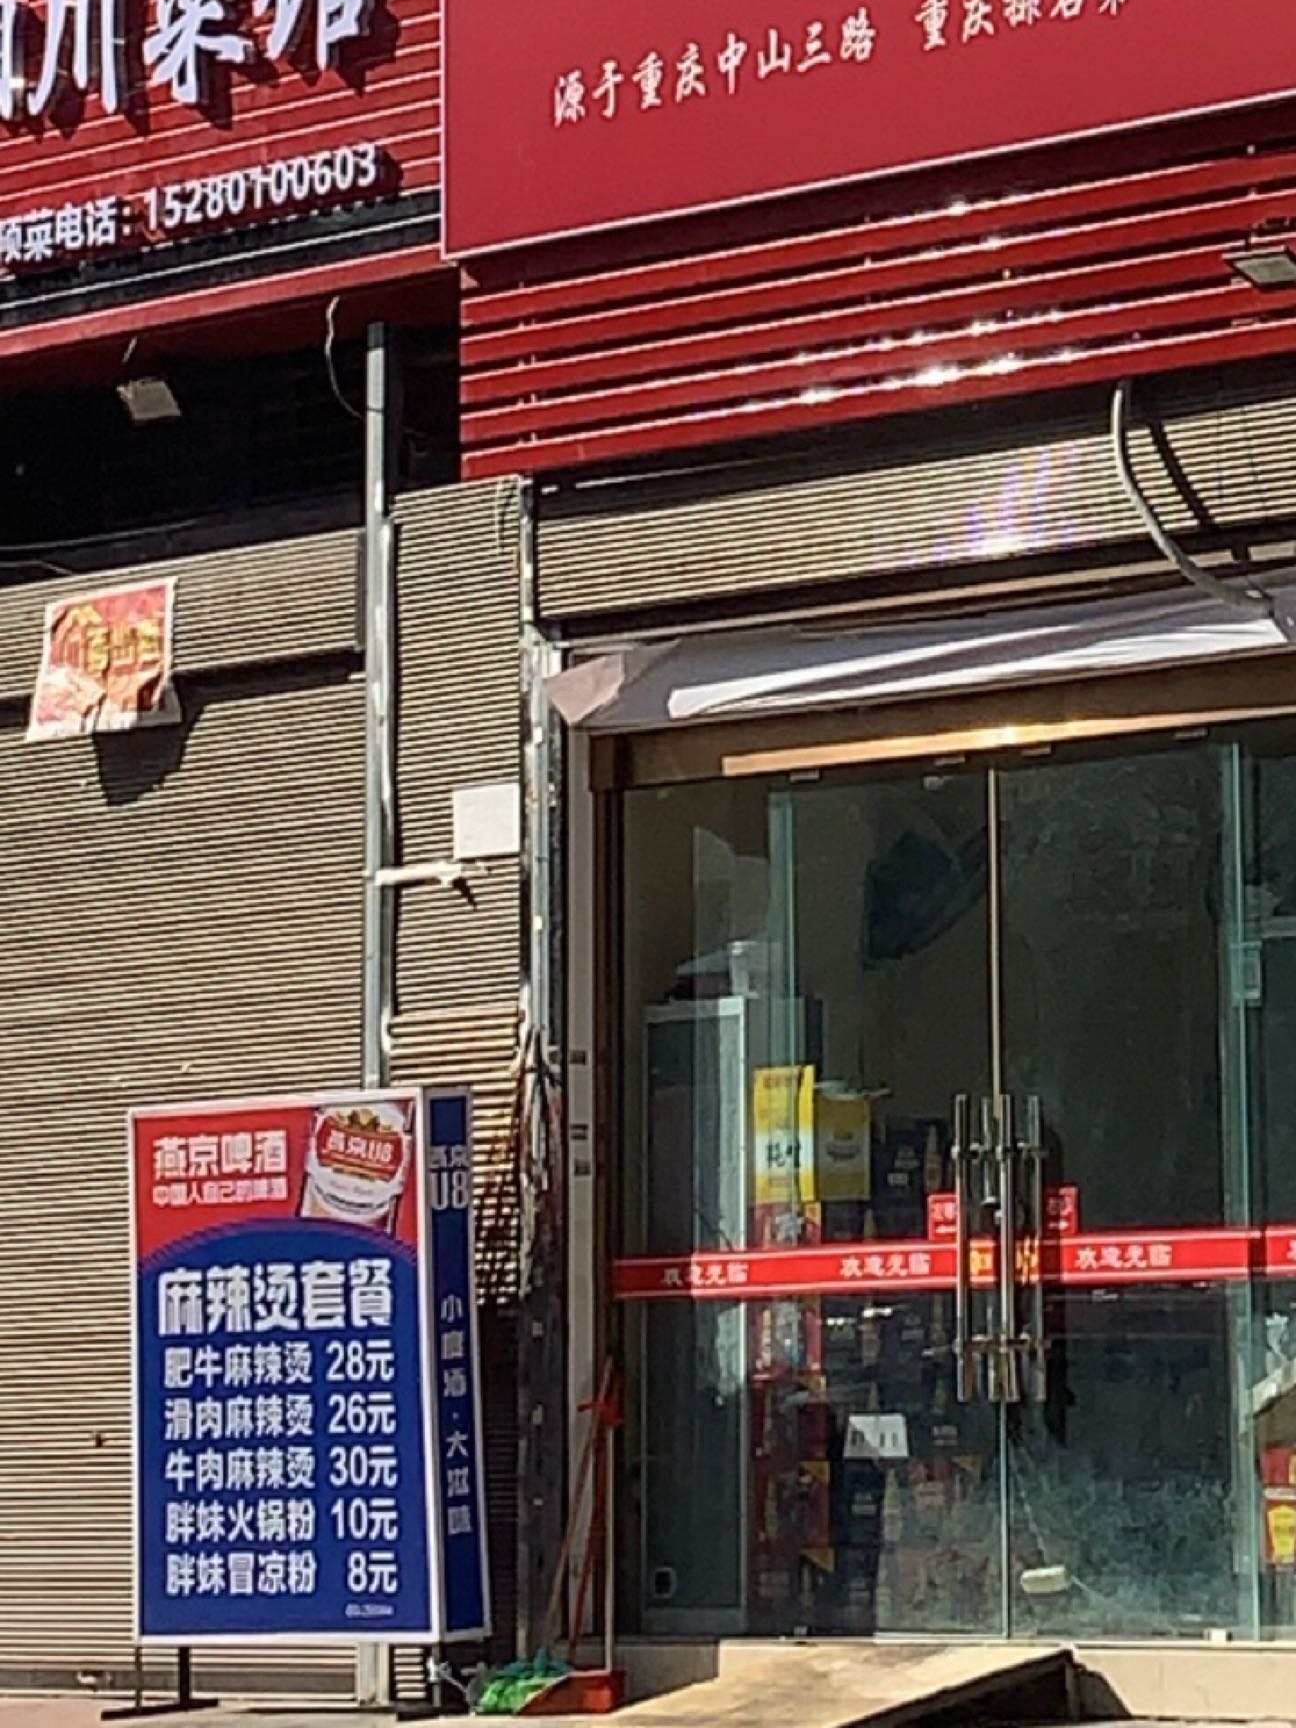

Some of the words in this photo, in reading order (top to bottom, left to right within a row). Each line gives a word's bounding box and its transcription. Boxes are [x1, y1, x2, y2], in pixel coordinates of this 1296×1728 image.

[553, 6, 877, 129] 源于重庆中山三路
[152, 1129, 288, 1181] 燕京啤酒
[839, 1252, 931, 1278] 欢迎光临
[1075, 1244, 1173, 1270] 欢迎光临
[158, 1257, 393, 1338] 麻辣烫套餐
[163, 1340, 313, 1389] 肥牛麻辣烫
[325, 1338, 395, 1382] 28元
[163, 1393, 314, 1441] 滑肉麻辣烫
[327, 1391, 397, 1434] 26元
[164, 1446, 316, 1493] 牛肉麻辣烫
[328, 1444, 398, 1488] 30元
[164, 1497, 317, 1545] 胖妹火锅粉
[330, 1496, 398, 1541] 10元
[164, 1549, 318, 1597] 胖妹冒凉粉
[346, 1550, 398, 1594] 8元
